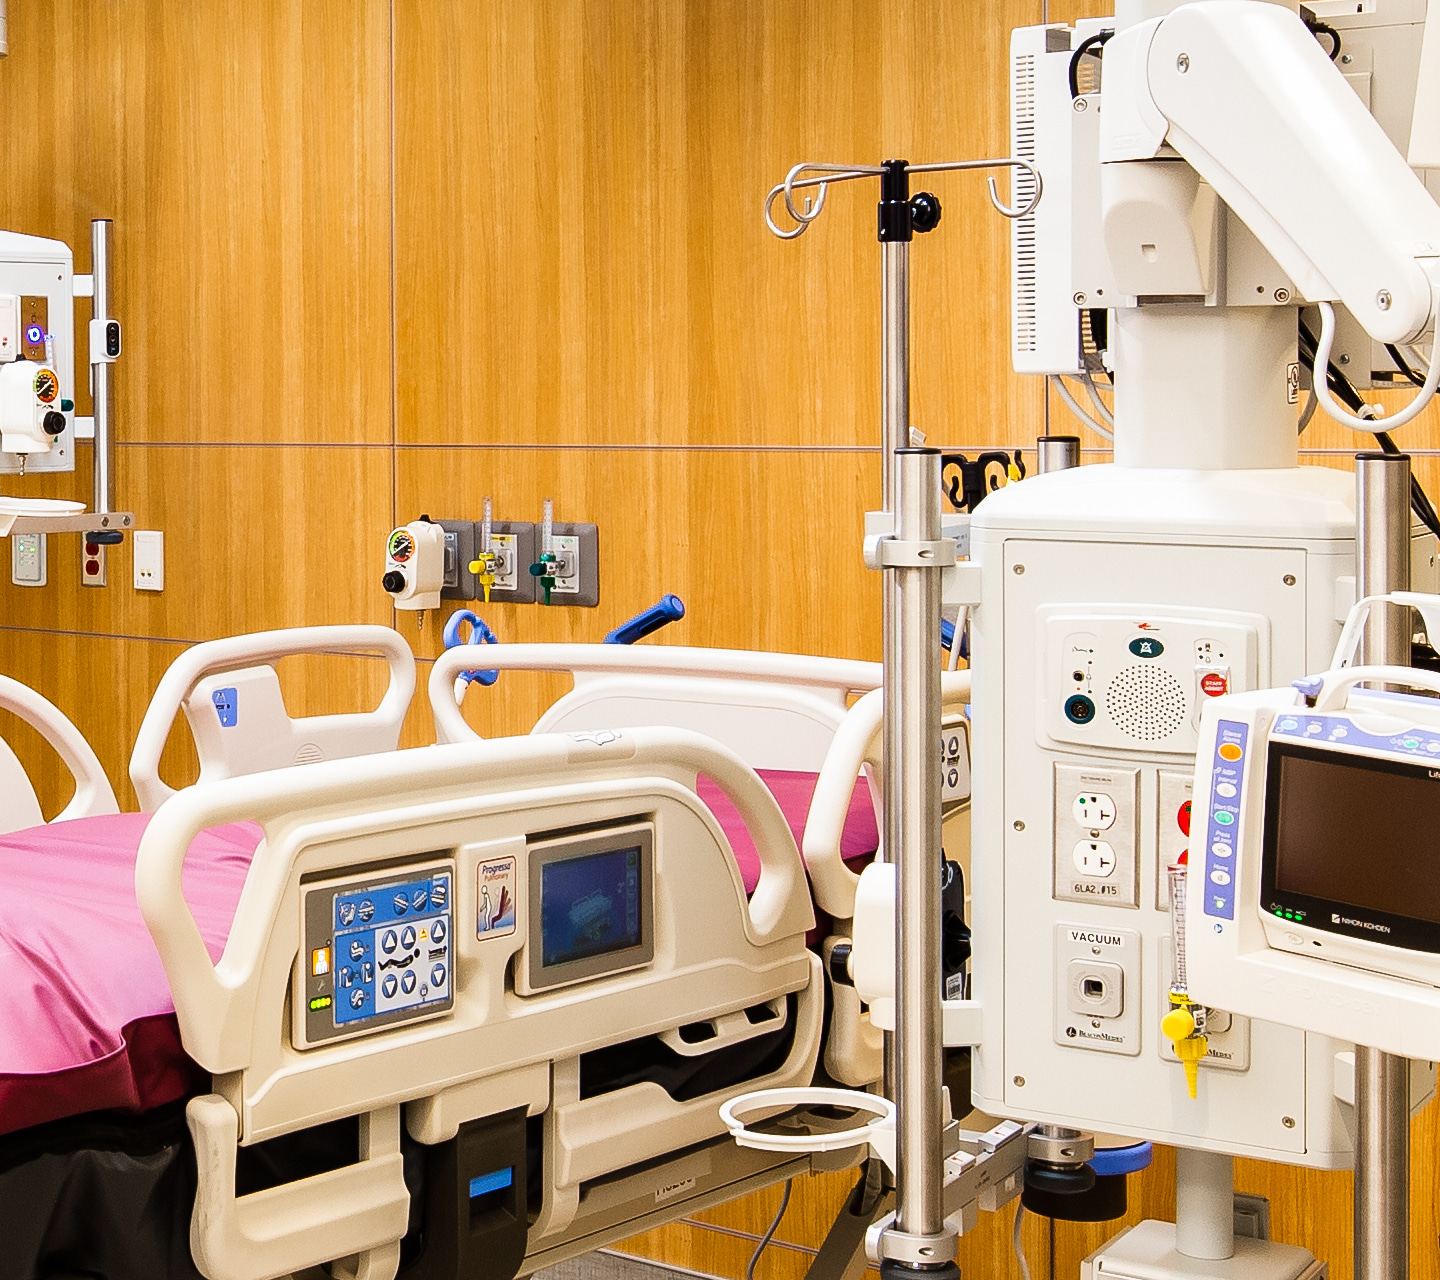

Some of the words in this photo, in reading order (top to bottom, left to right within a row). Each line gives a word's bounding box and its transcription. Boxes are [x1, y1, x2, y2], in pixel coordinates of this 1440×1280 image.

[483, 862, 511, 876] Progressa
[1342, 917, 1363, 928] NIHON
[1363, 922, 1391, 934] KOHDEN
[1072, 931, 1121, 946] VACUUM
